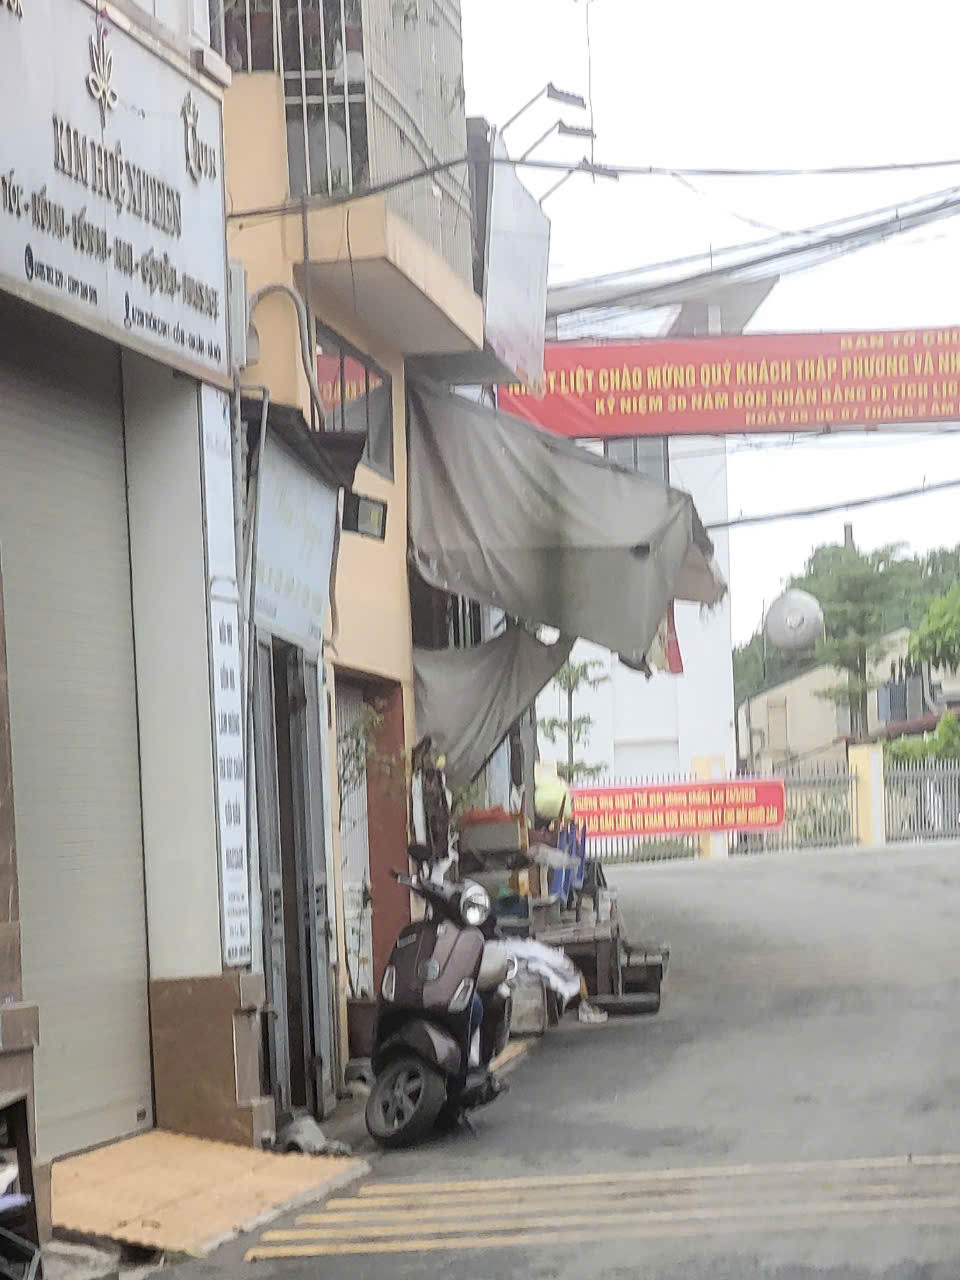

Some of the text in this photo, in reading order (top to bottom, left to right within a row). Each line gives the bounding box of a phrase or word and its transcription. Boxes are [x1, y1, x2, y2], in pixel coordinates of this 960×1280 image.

[560, 364, 595, 399] LIỆT
[598, 362, 642, 393] CHÀO
[647, 361, 696, 391] MỪNG
[700, 358, 731, 388] QUÝ
[736, 356, 791, 386] KHÁCH
[841, 353, 909, 381] PHƯƠNG
[913, 349, 935, 377] VÀ
[691, 391, 729, 412] NĂM
[870, 384, 887, 401] DI
[892, 380, 928, 400] TÍCH
